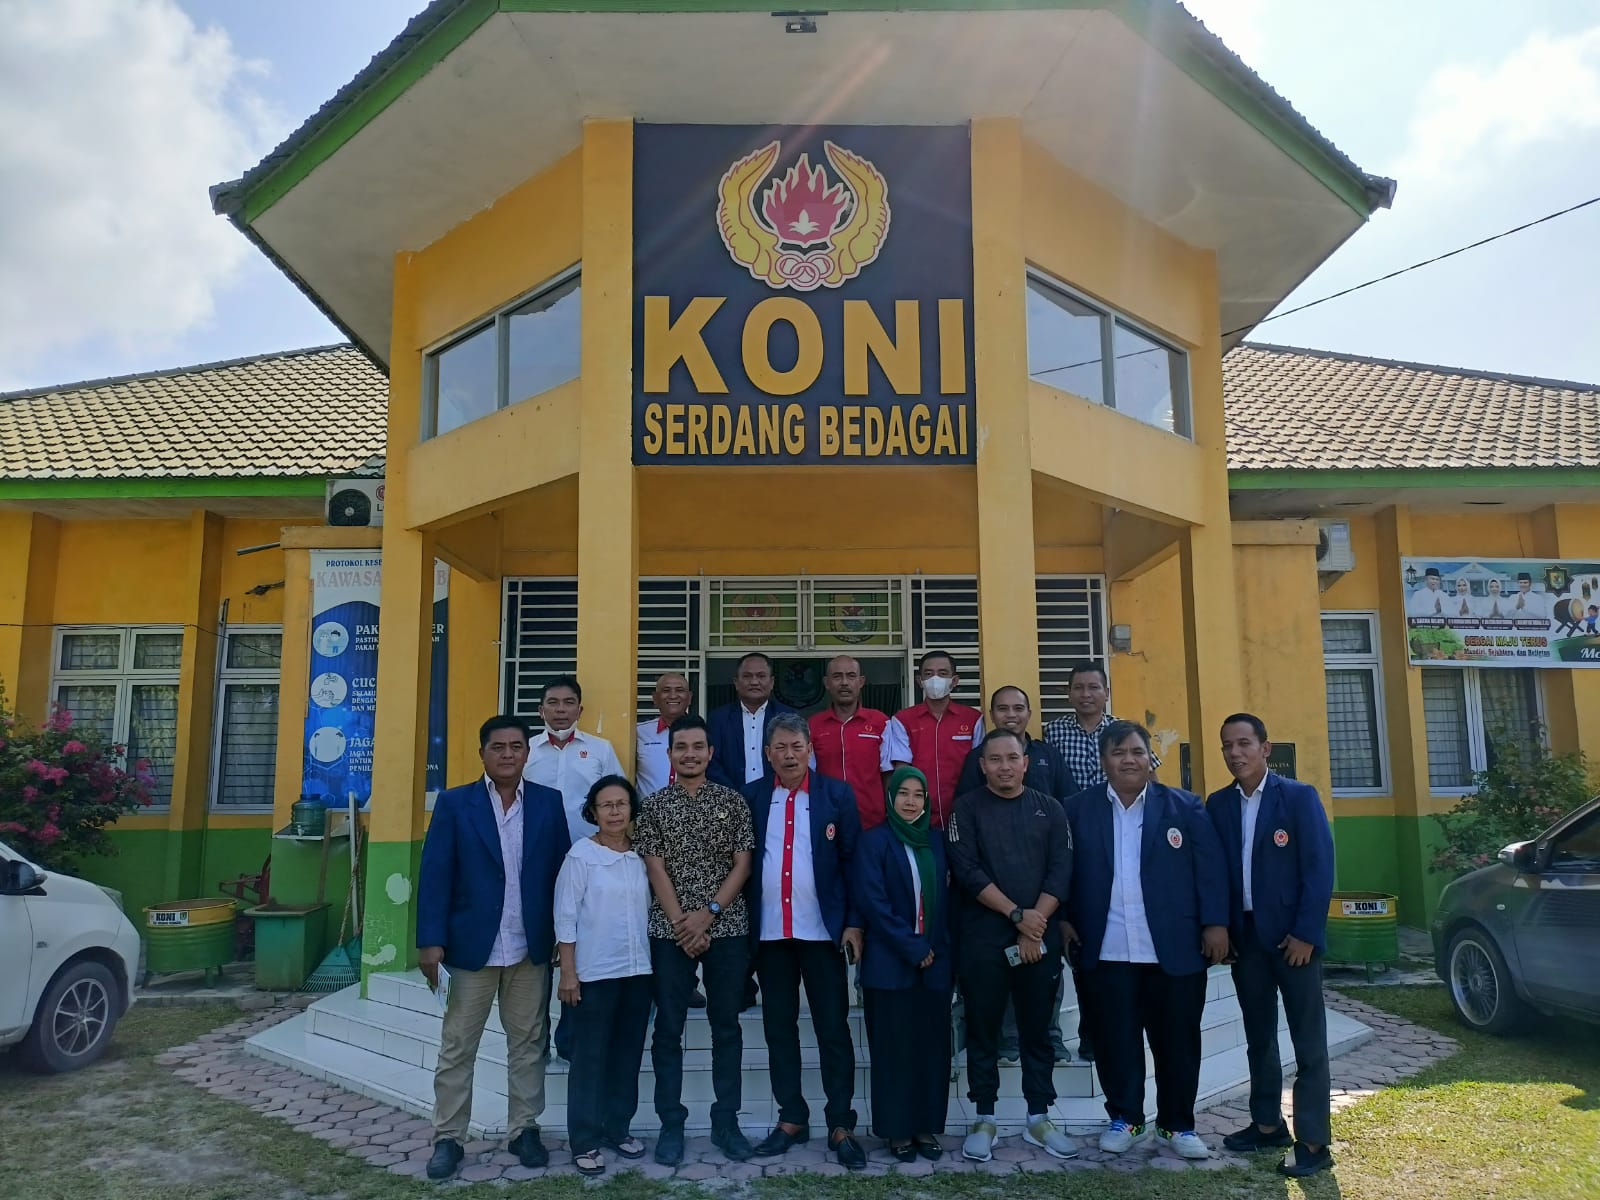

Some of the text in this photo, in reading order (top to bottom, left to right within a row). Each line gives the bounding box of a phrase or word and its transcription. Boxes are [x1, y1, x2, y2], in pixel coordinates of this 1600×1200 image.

[643, 295, 966, 396] KONI
[643, 402, 967, 456] SERDANG BEDAGAI
[326, 559, 362, 567] PROTOKOL
[1464, 635, 1548, 648] SERGAI MAJU TERUS
[1355, 903, 1377, 911] KONI
[156, 913, 176, 921] KONI
